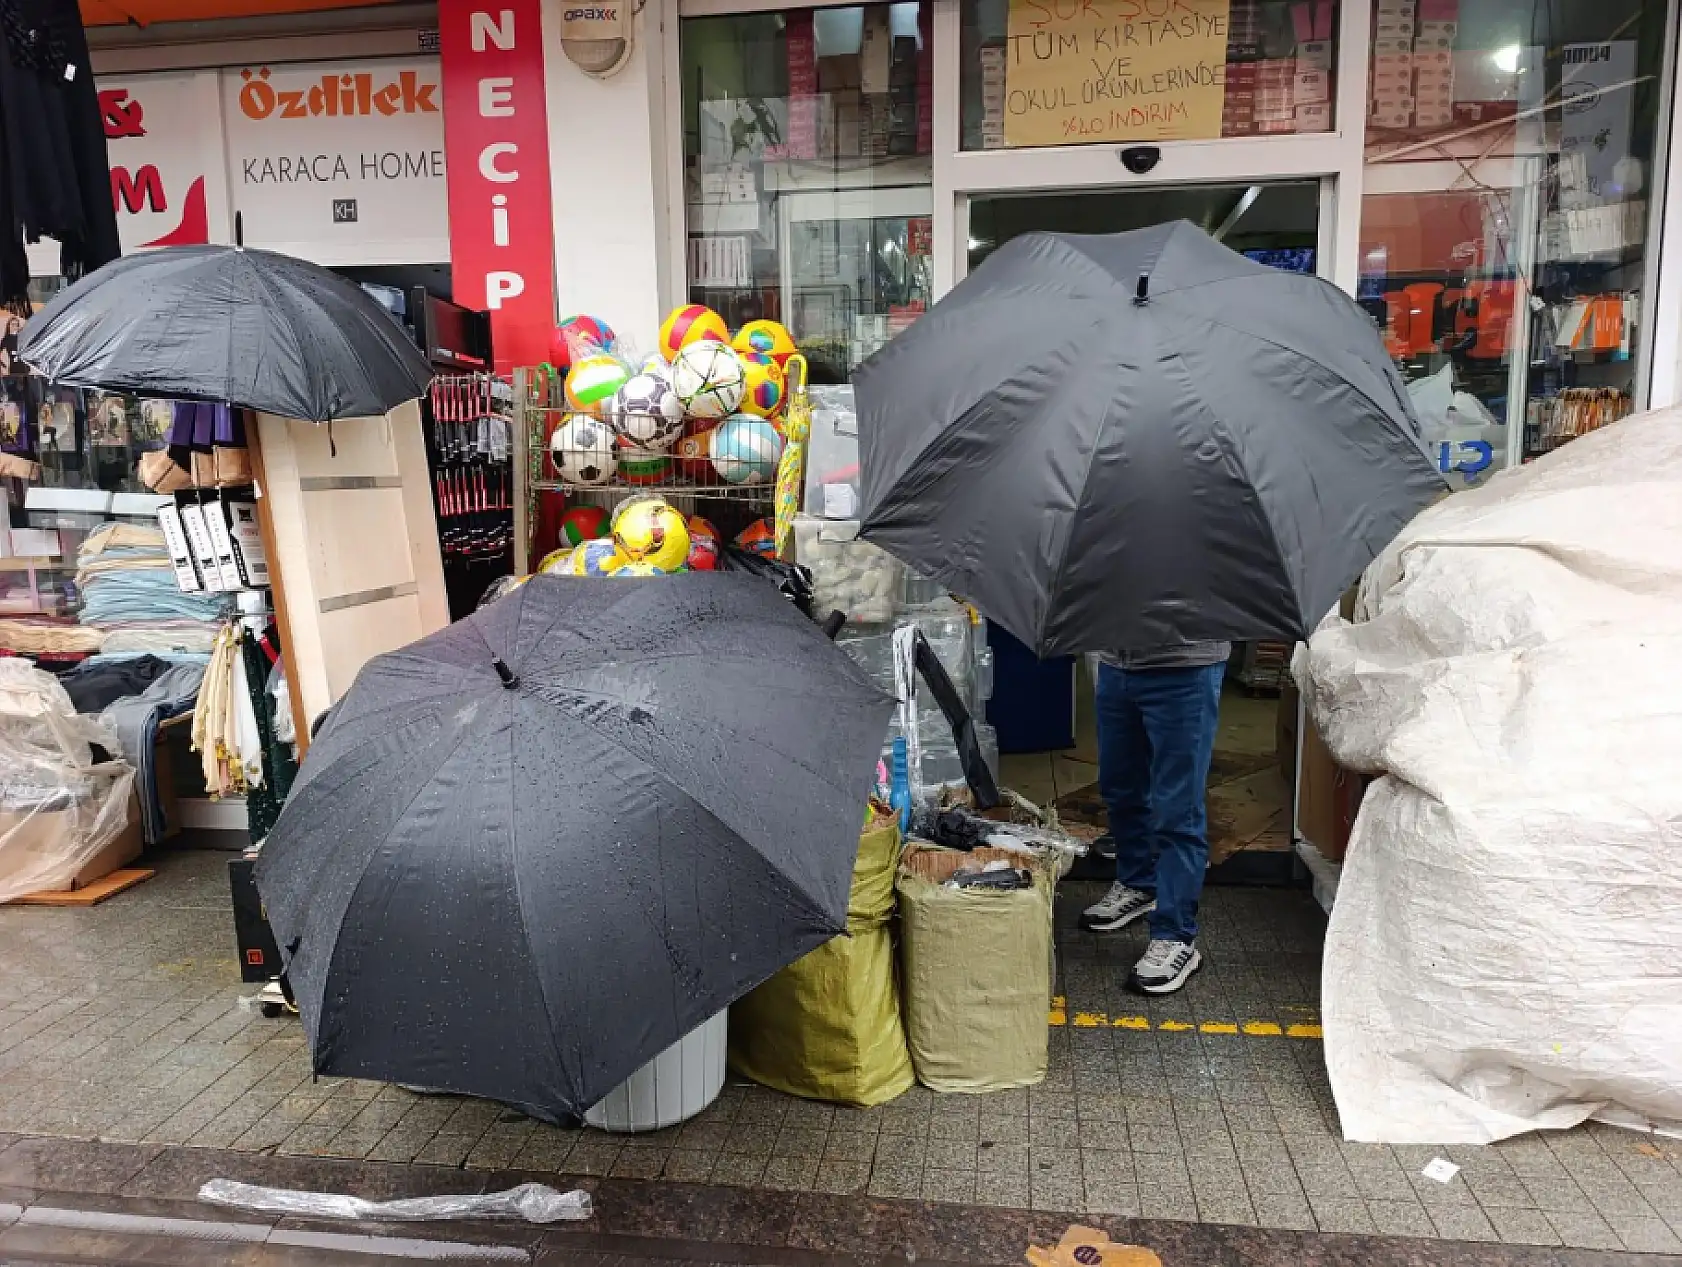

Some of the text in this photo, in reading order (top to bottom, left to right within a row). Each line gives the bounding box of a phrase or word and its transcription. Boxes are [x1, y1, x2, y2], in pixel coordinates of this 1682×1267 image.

[1008, 12, 1226, 64] TÜM KIRTASİYE
[1091, 56, 1132, 82] VE
[239, 65, 439, 120] Özdilek
[1008, 87, 1076, 115] OKUL
[243, 150, 443, 184] KARACA HOME
[335, 202, 356, 220] KH
